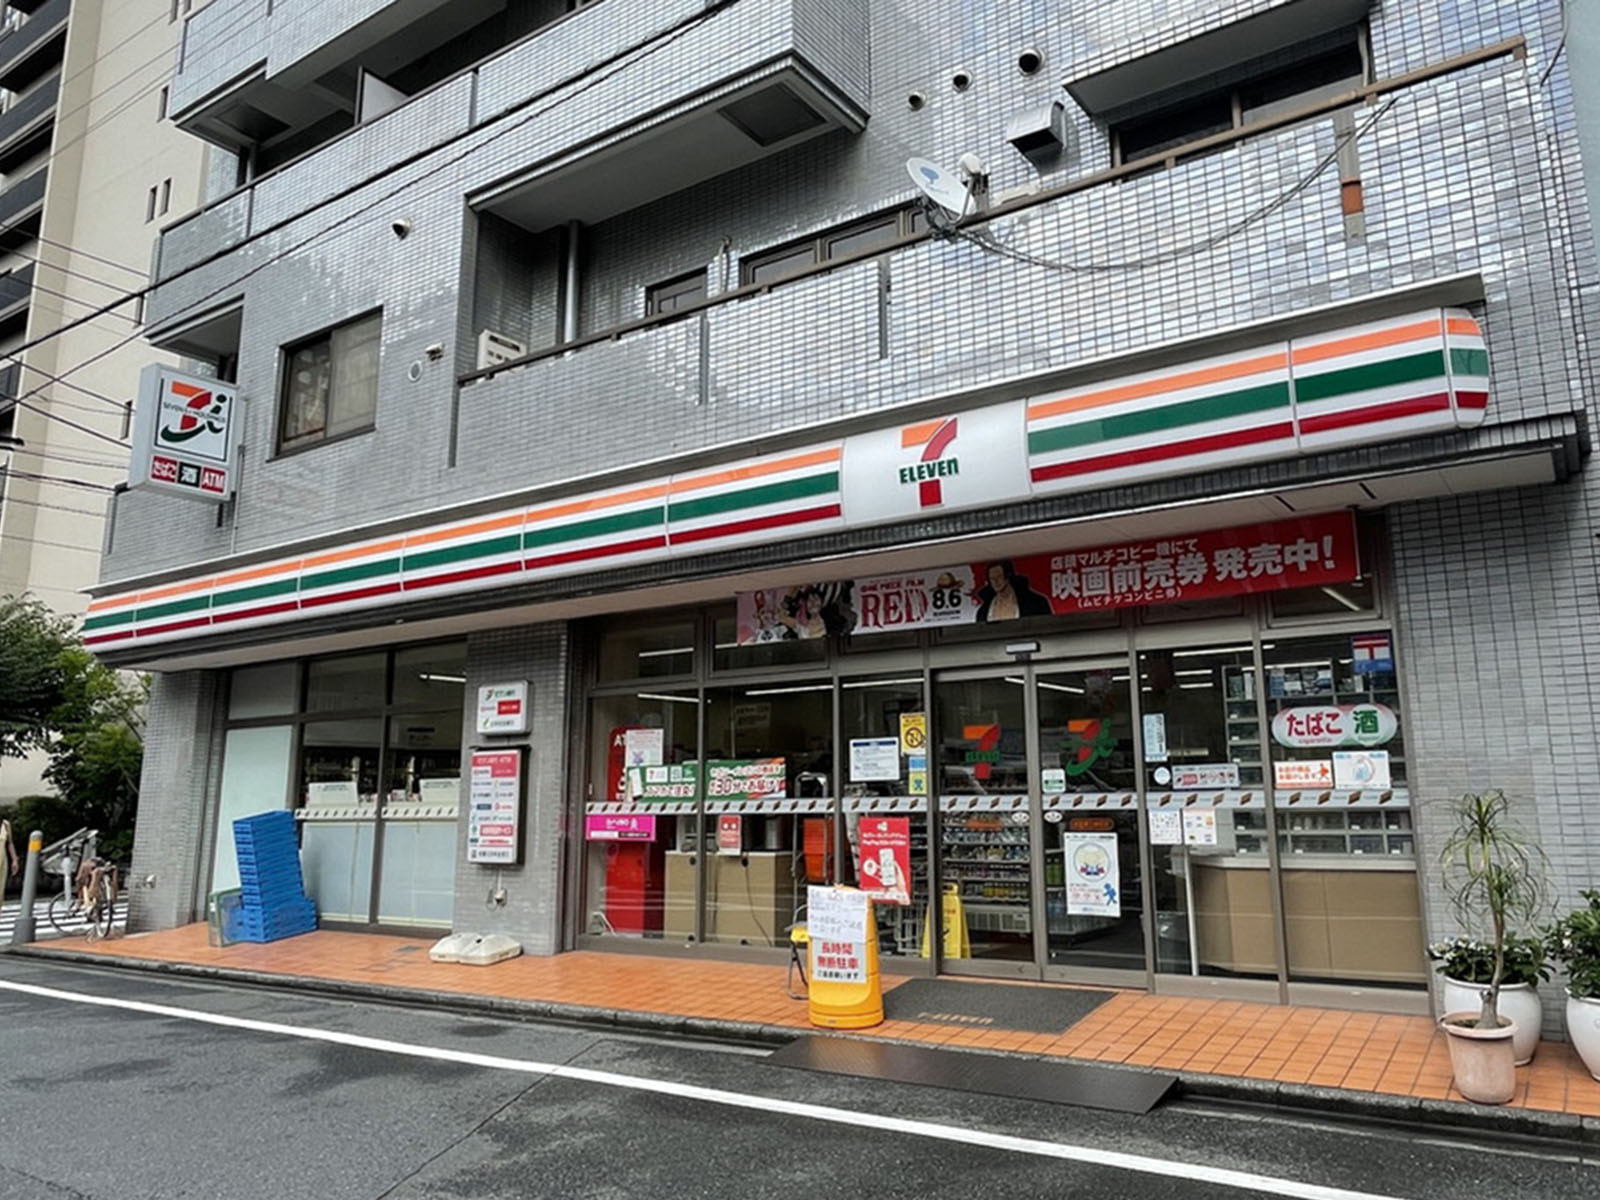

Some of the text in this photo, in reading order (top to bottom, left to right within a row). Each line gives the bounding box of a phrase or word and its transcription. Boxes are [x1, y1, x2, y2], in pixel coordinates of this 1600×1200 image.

[202, 472, 225, 489] ATM
[1051, 552, 1209, 600] 映画前売券
[861, 588, 929, 629] RED
[931, 588, 962, 610] 8.6
[1286, 710, 1380, 737] たばこ 酒
